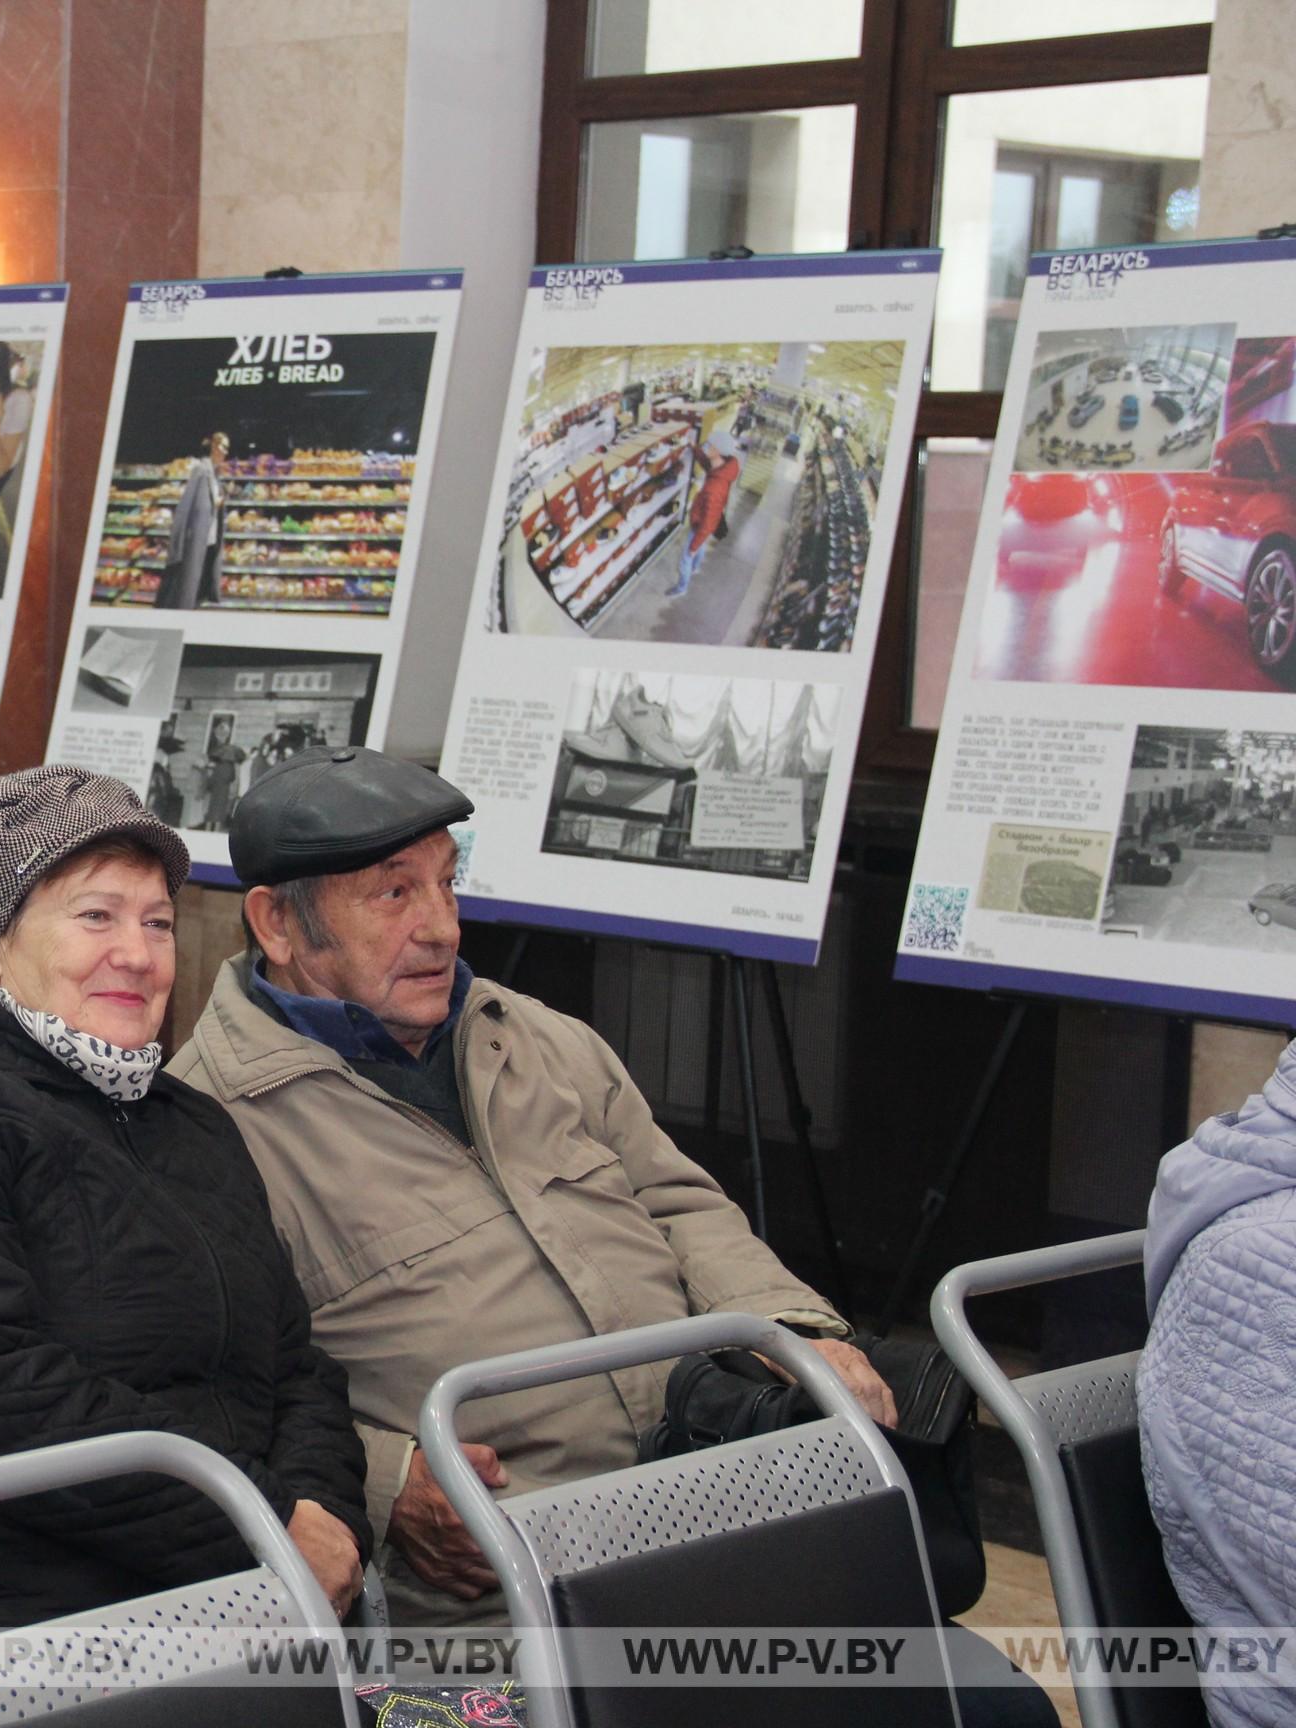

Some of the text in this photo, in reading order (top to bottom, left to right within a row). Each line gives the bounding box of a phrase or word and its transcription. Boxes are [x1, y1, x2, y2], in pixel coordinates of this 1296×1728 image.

[1048, 251, 1150, 275] БЕЛАРУСЬ
[545, 268, 625, 287] БЕЛАРУСЬ
[214, 363, 345, 387] ХЛЕБ BREAD
[997, 828, 1043, 841] Стадион
[1058, 832, 1092, 847] базар
[1016, 841, 1080, 856] безобразие
